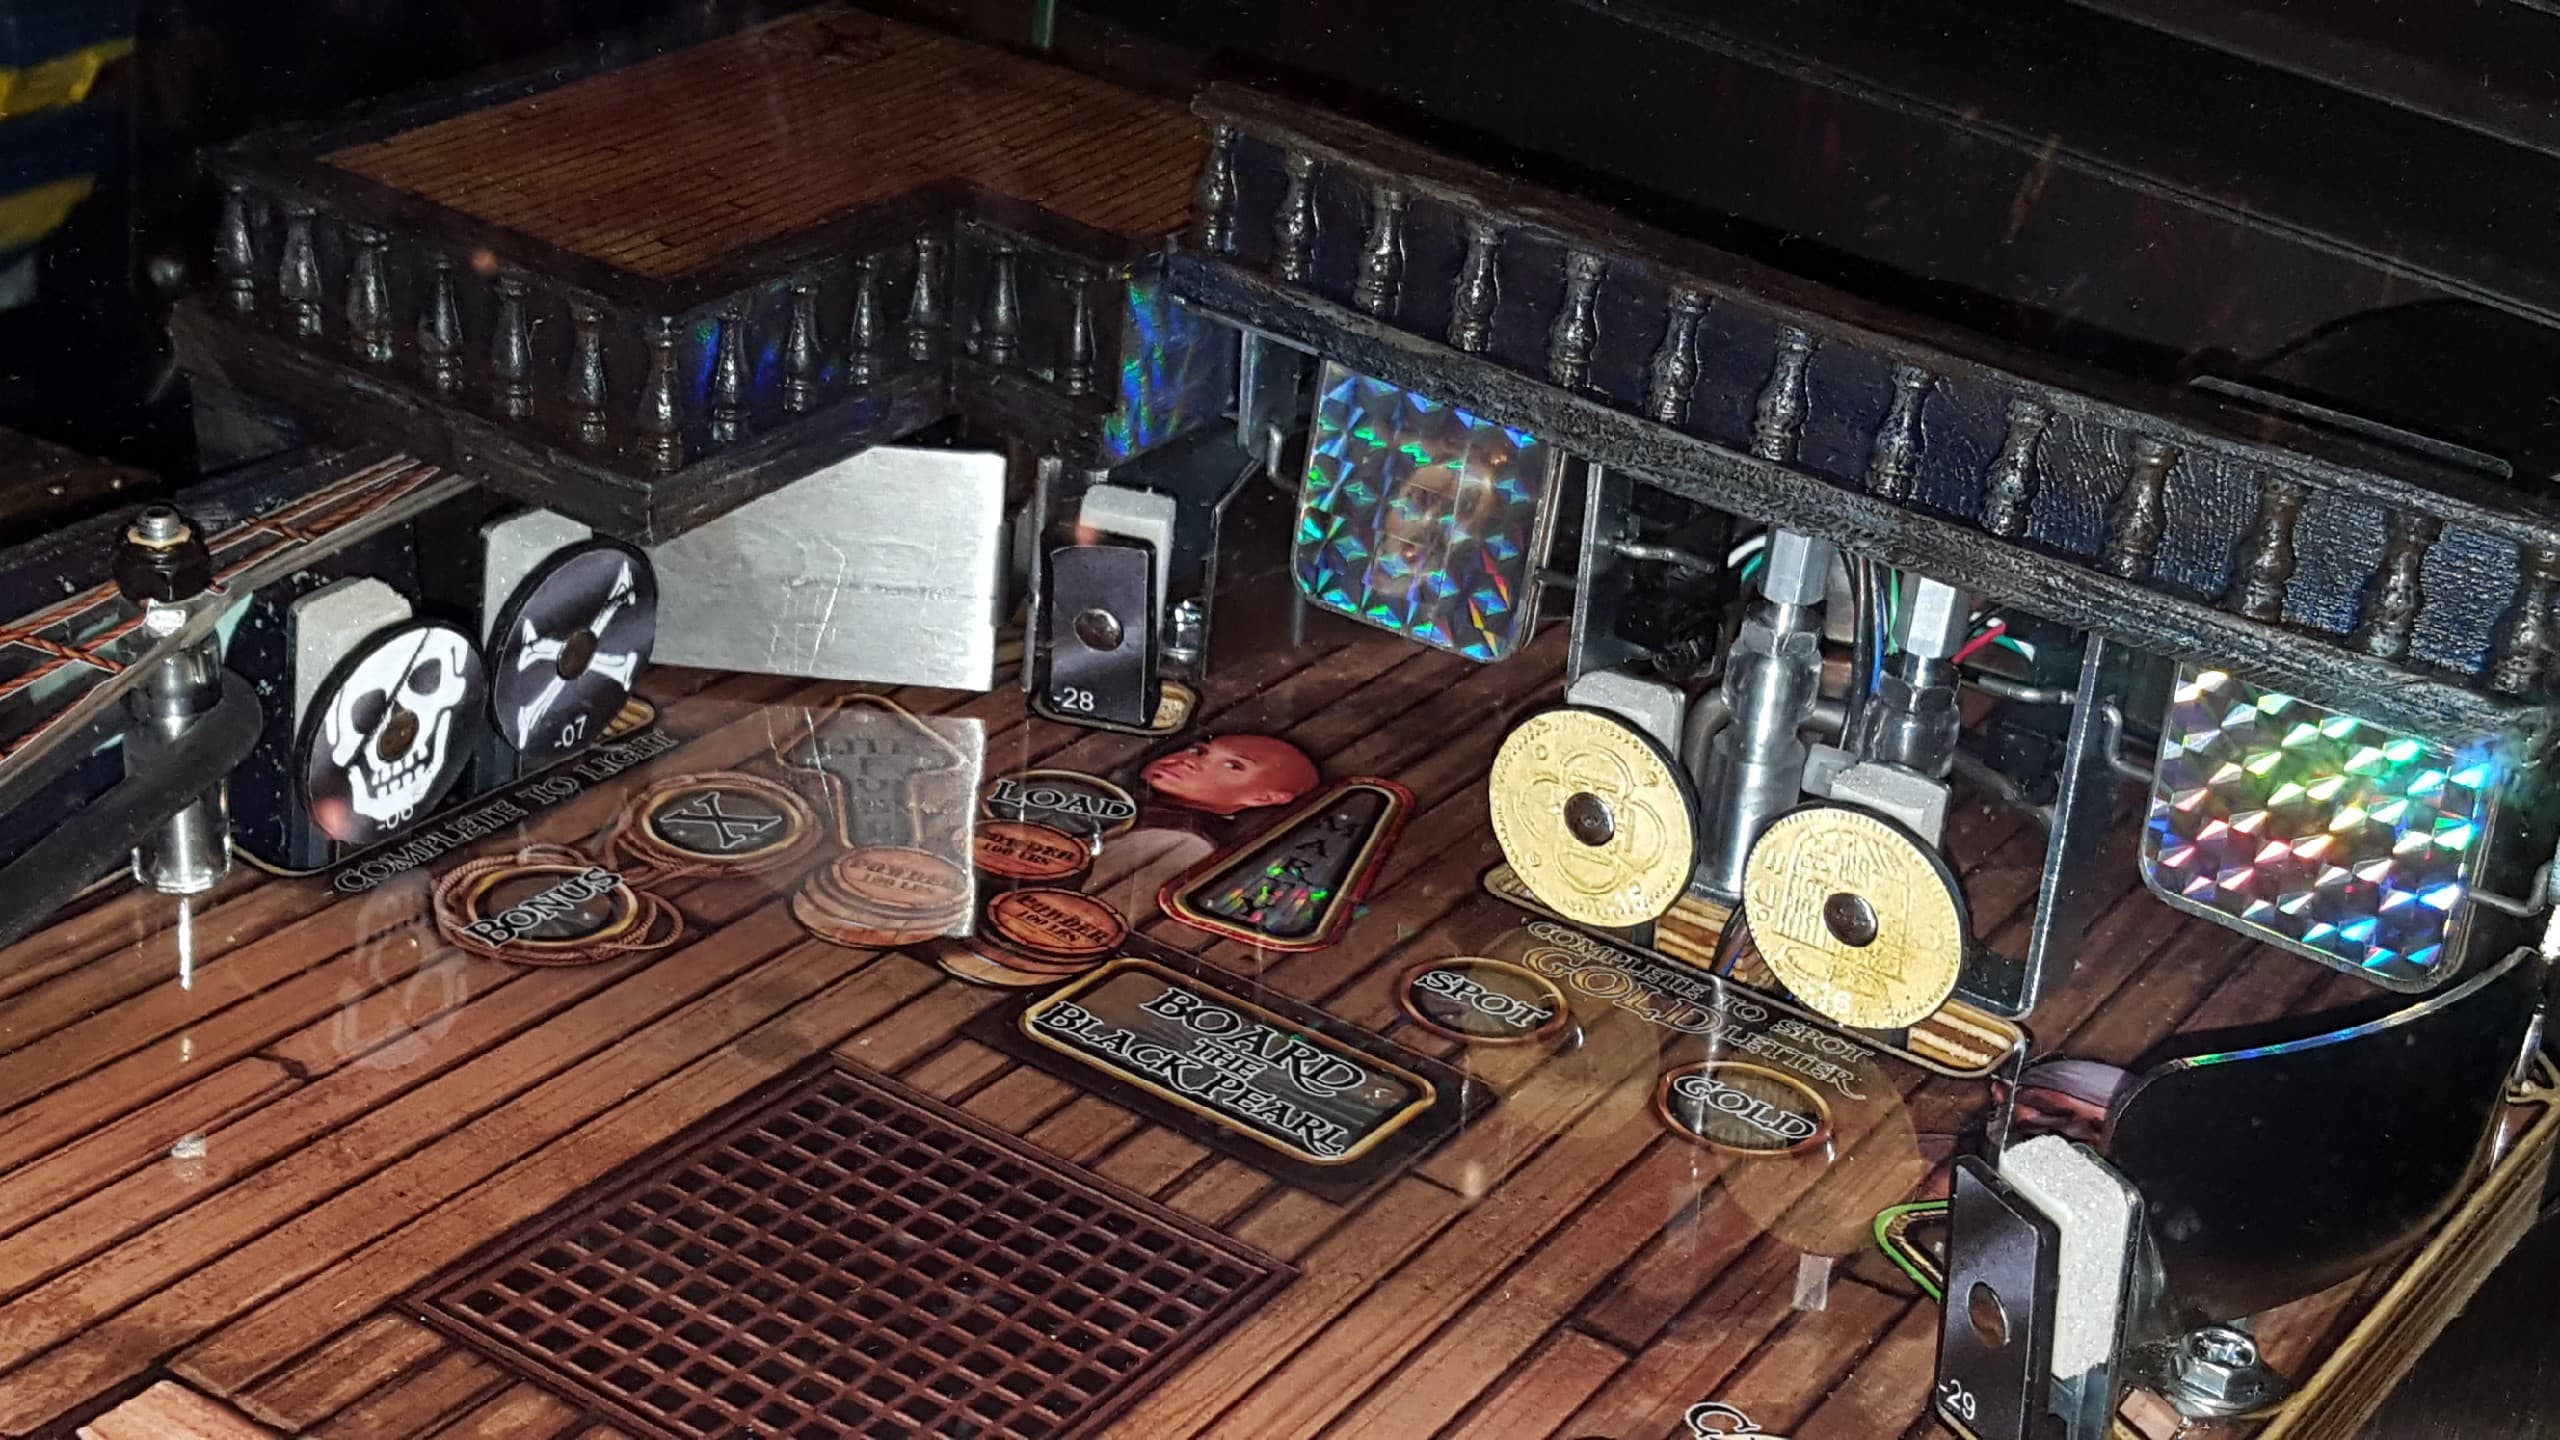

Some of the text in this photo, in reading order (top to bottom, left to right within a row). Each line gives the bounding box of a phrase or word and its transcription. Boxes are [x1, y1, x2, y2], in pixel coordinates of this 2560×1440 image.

[1053, 687, 1095, 711] -28
[553, 715, 588, 749] -07
[334, 727, 680, 893] COMPLETE TO LIGHT
[659, 791, 783, 849] X
[986, 778, 1137, 820] LOAD
[464, 866, 624, 948] BONUS
[1414, 970, 1554, 1029] SPOT
[1523, 947, 1867, 1100] GOLD LETTER
[1527, 921, 1875, 1065] COMPLETE TO SPOT
[1140, 987, 1366, 1098] BOARD
[1186, 1037, 1268, 1081] THE
[1035, 1001, 1348, 1161] BLACK PEARL
[1673, 1075, 1819, 1140] GOLD
[1938, 1379, 1976, 1420] -29
